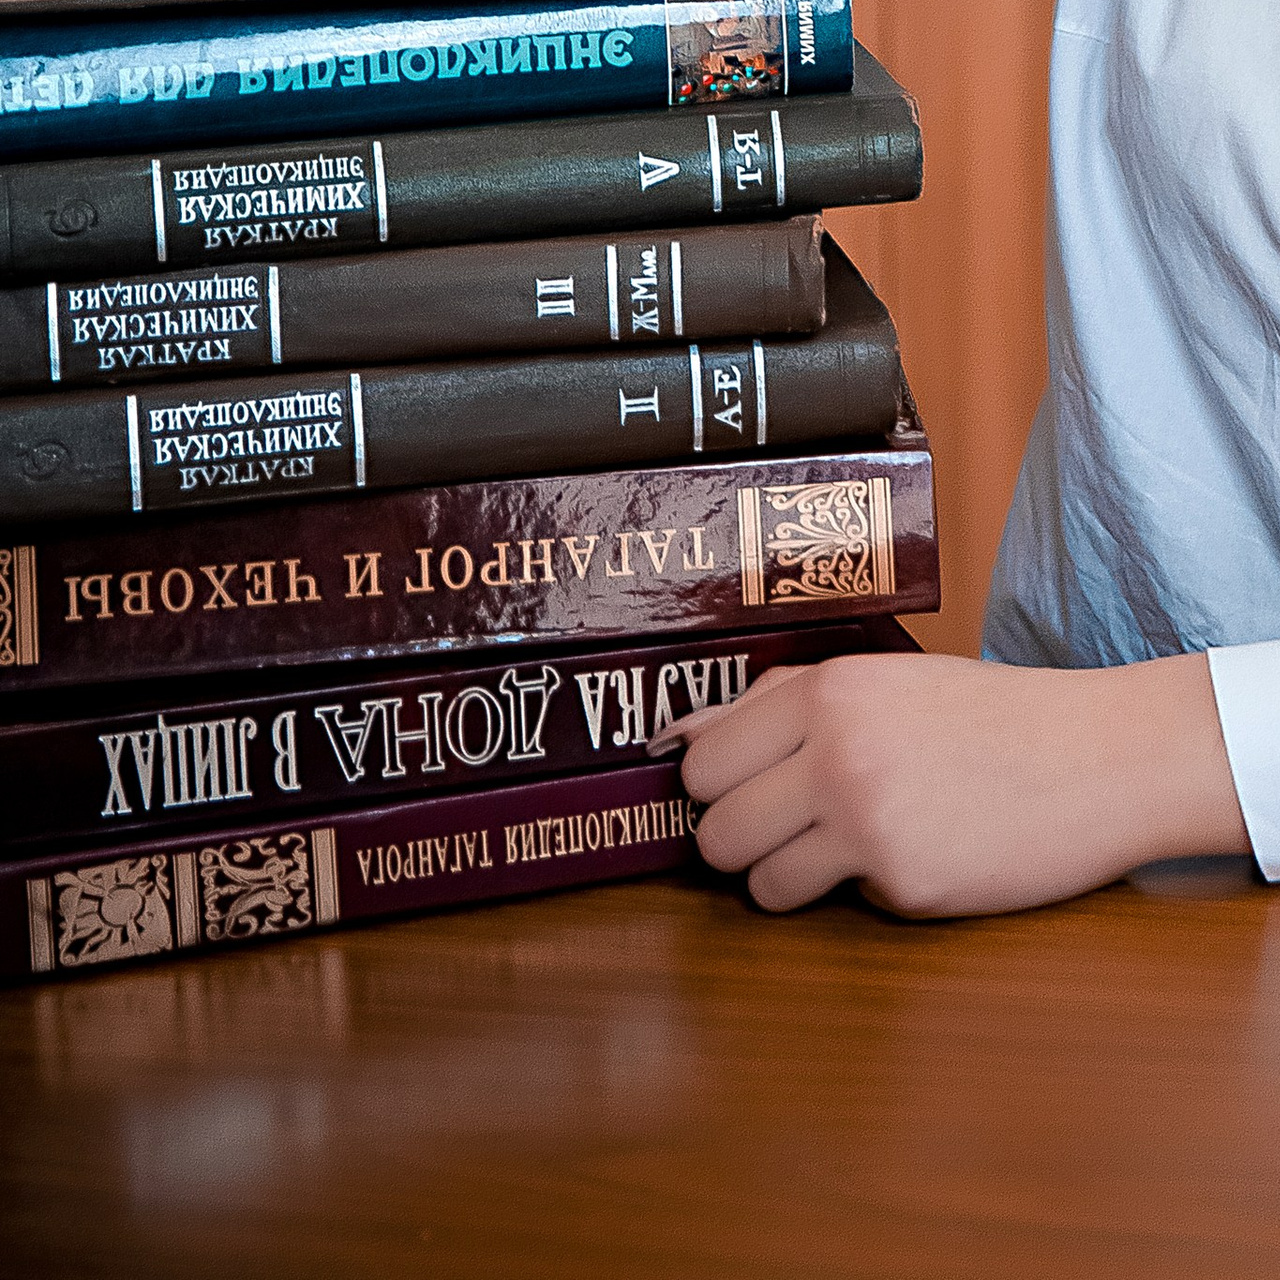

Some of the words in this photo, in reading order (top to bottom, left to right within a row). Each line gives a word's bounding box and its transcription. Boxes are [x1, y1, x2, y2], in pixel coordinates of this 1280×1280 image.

[796, 0, 816, 66] ХИМИЯ
[118, 61, 215, 106] ДЛЯ
[237, 29, 635, 96] ЭНЦИКЛОПЕДИЯ
[0, 69, 96, 115] ДЕТ
[172, 153, 365, 192] ЭНЦИКЛОПЕДИЯ
[638, 151, 681, 191] V
[177, 181, 366, 225] ХИМИЧЕСКАЯ
[203, 216, 339, 250] КРАТКАЯ
[67, 272, 260, 312] ЭНЦИКЛОПЕДИЯ
[71, 303, 260, 345] ХИМИЧЕСКАЯ
[97, 337, 233, 370] КРАТКАЯ
[148, 390, 343, 433] ЭНЦИКЛОПЕДИЯ
[152, 420, 344, 466] ХИМИЧЕСКАЯ
[178, 455, 315, 490] КРАТКАЯ
[342, 552, 385, 598] И
[404, 526, 715, 594] ТАГАНРОГ
[63, 558, 322, 623] ЧЕХОВЫ
[314, 664, 565, 783] ДОНА
[98, 713, 258, 817] ЛИЦАХ
[272, 710, 302, 792] В
[504, 798, 699, 865] ЭНЦИКЛОПЕДИЯ
[355, 829, 493, 887] ТАГАНРОГА
